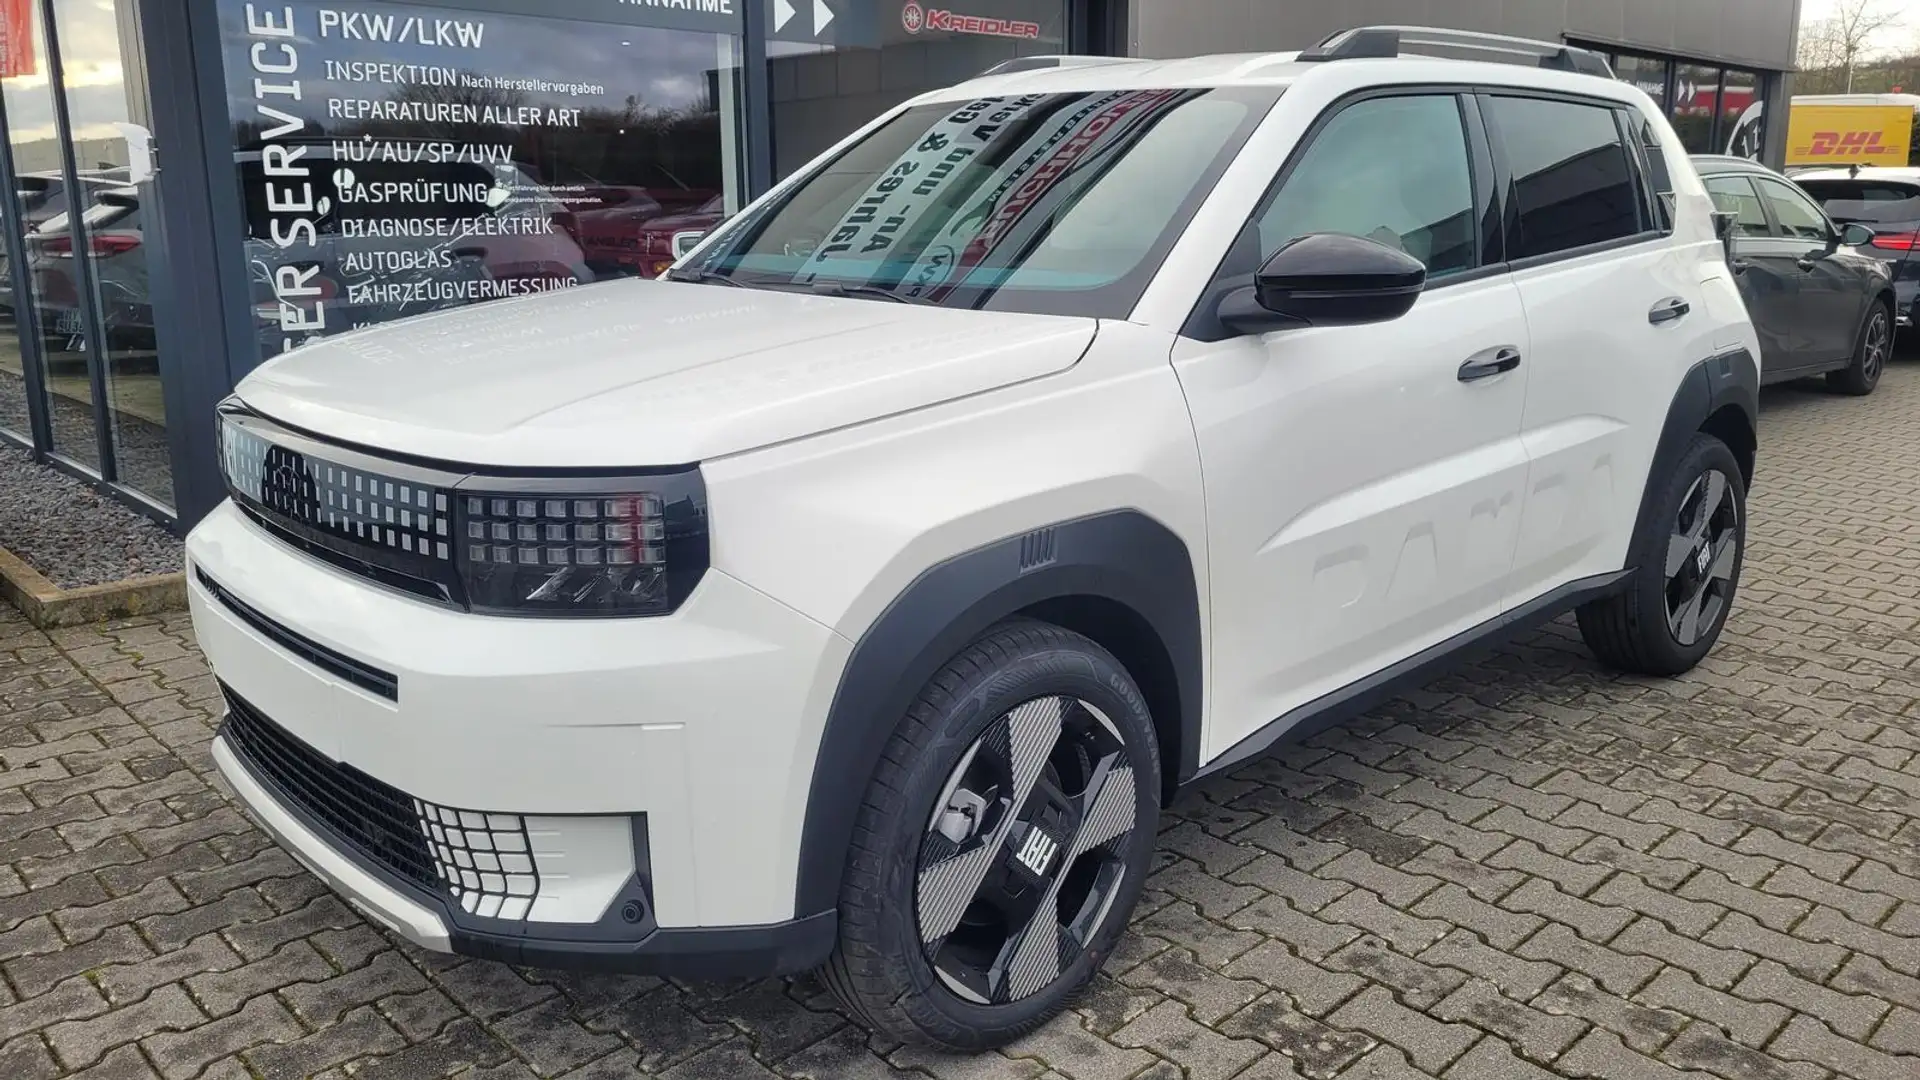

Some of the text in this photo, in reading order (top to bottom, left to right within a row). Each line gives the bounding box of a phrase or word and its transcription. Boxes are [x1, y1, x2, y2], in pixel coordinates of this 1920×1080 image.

[319, 9, 484, 48] PKW/LKW
[926, 9, 1039, 38] KREIDLER
[324, 60, 604, 96] INSPEKTION Nach Herstellervorgaben
[246, 3, 317, 248] SERVICE
[328, 98, 581, 127] REPARATUREN ALLER ART
[1808, 132, 1886, 155] DHL
[338, 179, 487, 203] GASPRÜFUNG
[341, 217, 554, 238] DIAGNOSE/ELEKTRIK
[345, 249, 452, 271] AUTOGLAS
[346, 277, 578, 304] FAHRZEUGVERMESSUNG
[1016, 826, 1057, 876] FIAT
